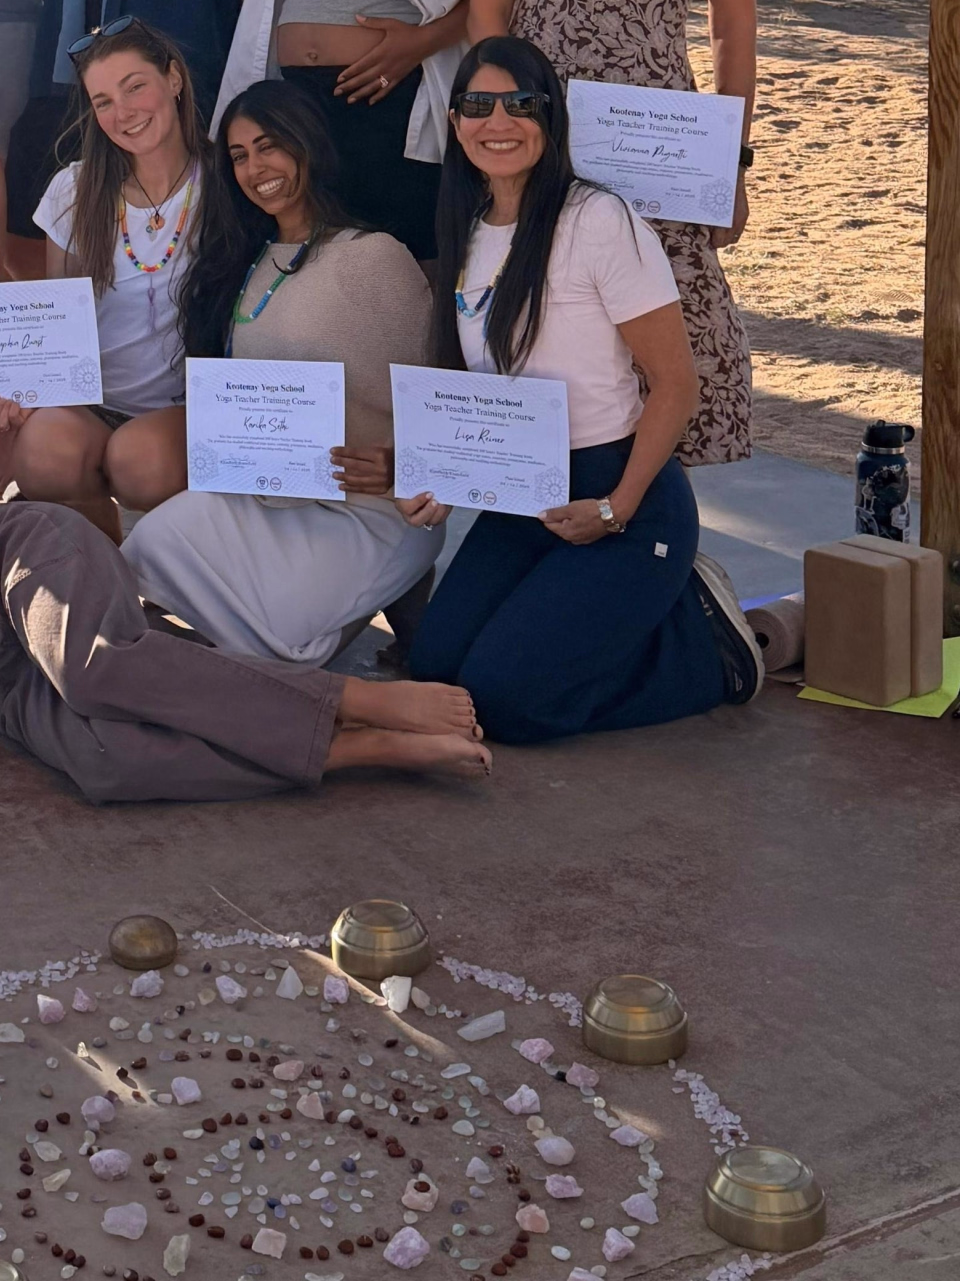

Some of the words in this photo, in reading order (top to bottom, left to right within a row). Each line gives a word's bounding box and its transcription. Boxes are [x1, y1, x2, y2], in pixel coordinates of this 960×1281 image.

[609, 106, 646, 119] Kootenay
[648, 110, 668, 120] Yoga
[670, 114, 697, 123] School
[597, 117, 615, 127] Yoga
[618, 120, 645, 129] Teacher
[649, 123, 679, 134] Training
[681, 127, 708, 136] Course
[30, 302, 54, 310] School
[13, 315, 40, 323] Training
[226, 382, 258, 392] Kootenay
[261, 384, 278, 392] Yoga
[215, 394, 232, 403] Yoga
[234, 395, 260, 403] Teacher
[262, 396, 290, 406] Training
[292, 398, 316, 406] Course
[435, 391, 471, 404] Kootenay
[474, 395, 494, 405] Yoga
[496, 398, 522, 408] School
[424, 402, 442, 412] Yoga
[445, 404, 473, 415] Teacher
[476, 408, 507, 420] Training
[508, 411, 535, 421] Course
